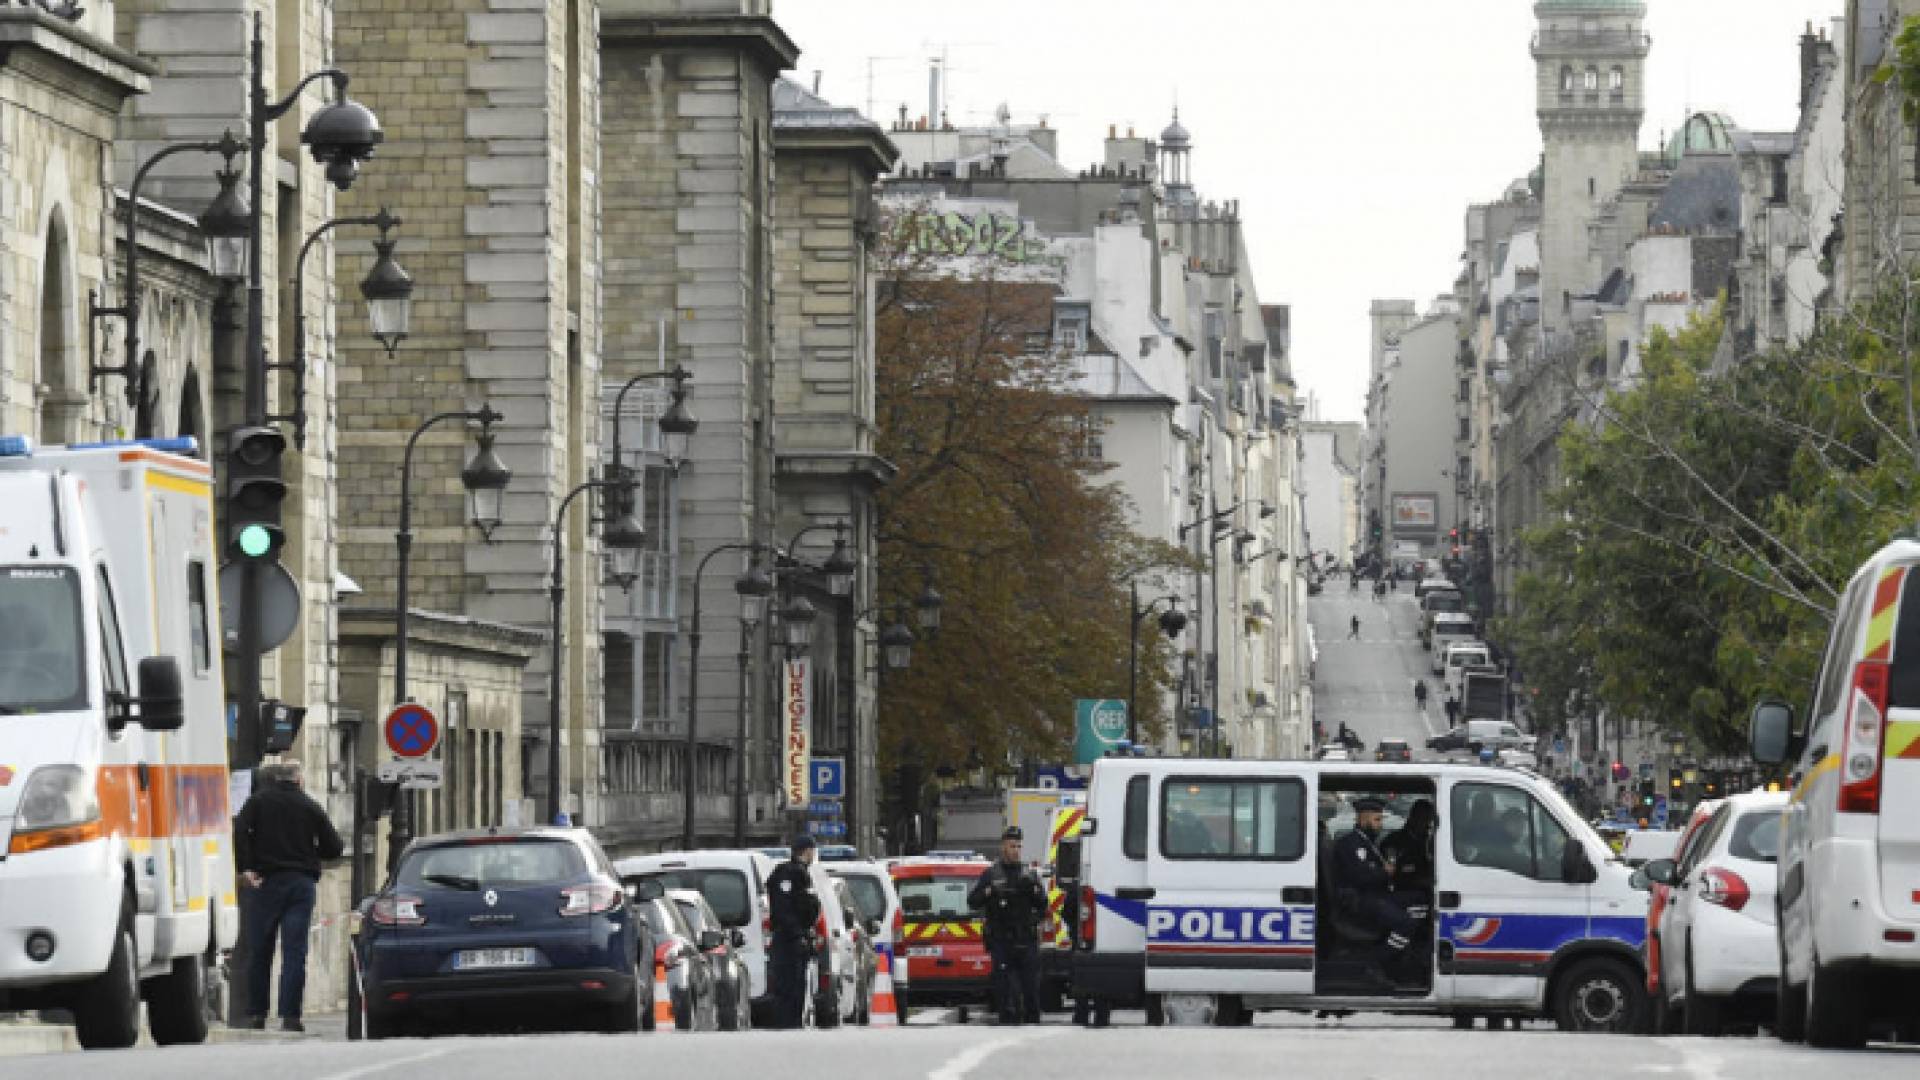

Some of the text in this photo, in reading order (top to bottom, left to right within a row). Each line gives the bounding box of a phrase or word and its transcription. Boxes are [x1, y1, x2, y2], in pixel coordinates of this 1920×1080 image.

[1096, 709, 1127, 730] RER
[788, 662, 806, 806] URGENCES
[817, 766, 833, 791] P
[1147, 910, 1315, 941] POLICE
